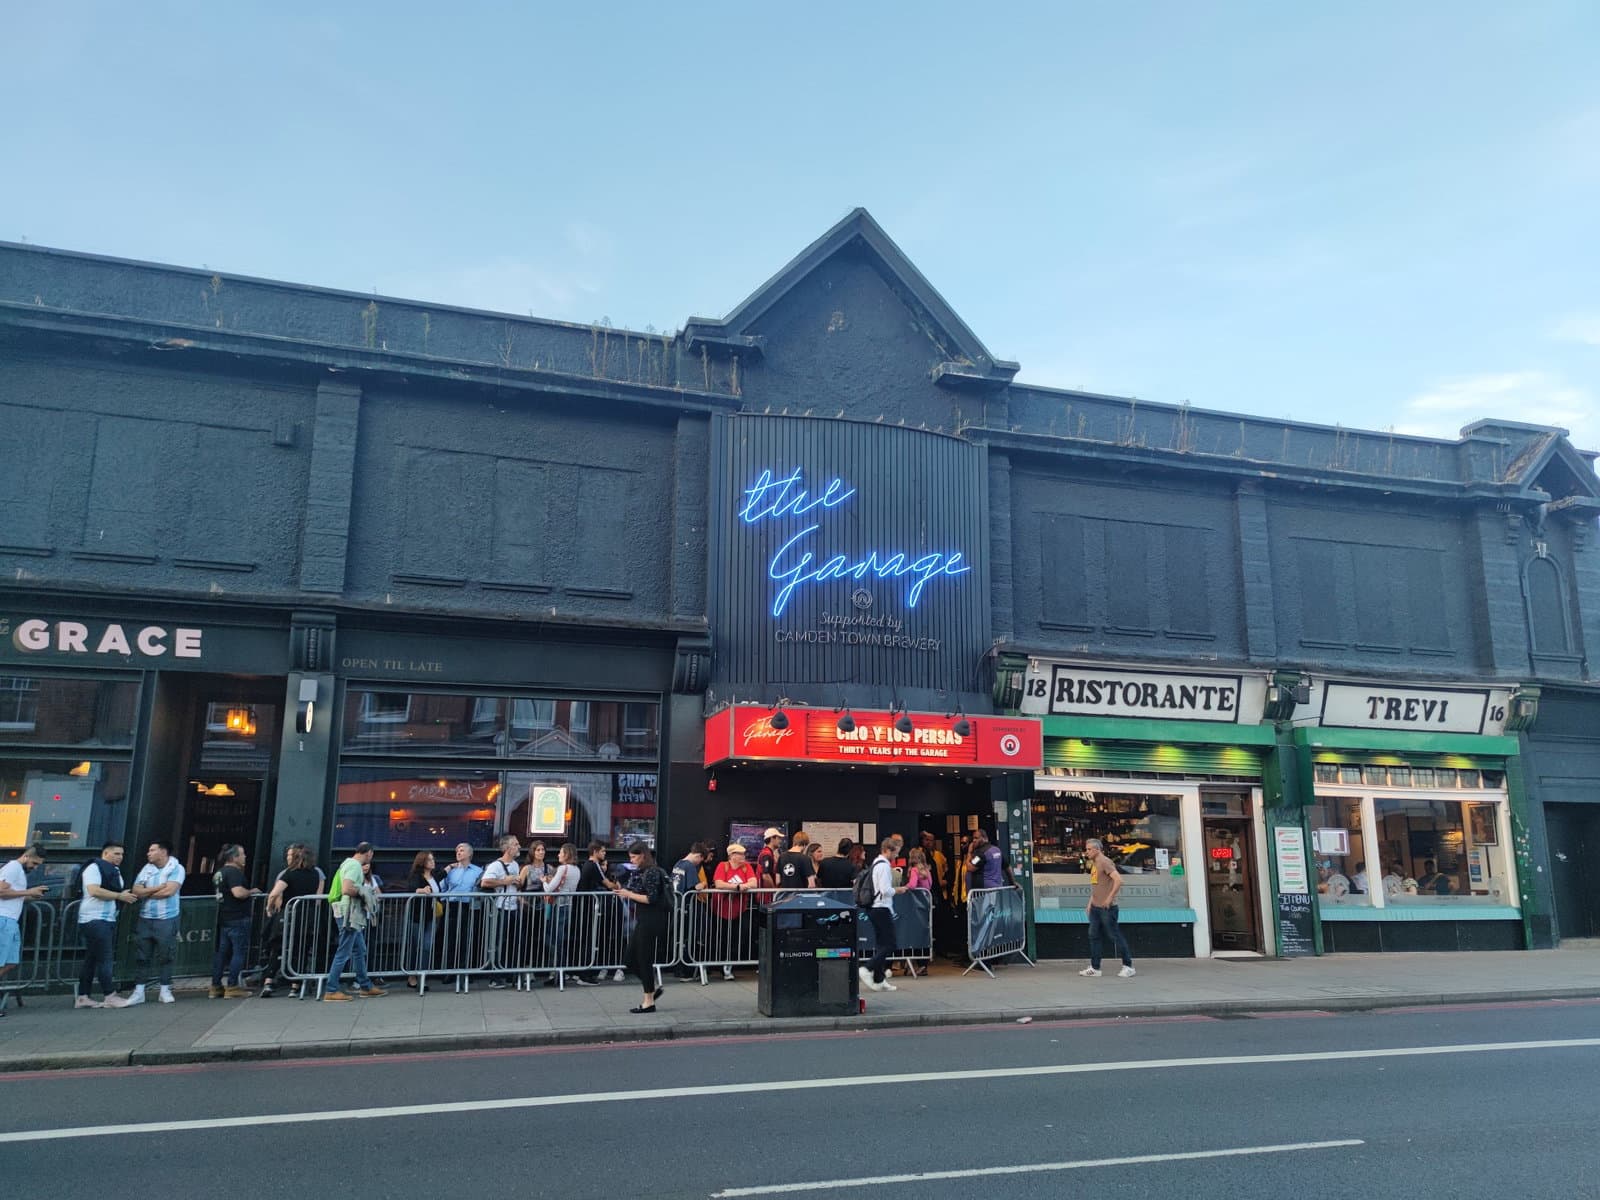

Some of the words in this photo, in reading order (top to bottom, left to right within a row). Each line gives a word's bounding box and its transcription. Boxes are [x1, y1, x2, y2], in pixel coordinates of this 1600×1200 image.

[739, 467, 856, 522] the
[770, 525, 971, 616] Garage
[820, 612, 885, 630] Supported
[887, 615, 904, 632] by
[15, 619, 202, 658] GRACE
[774, 629, 837, 644] CAMDEN
[840, 631, 881, 646] TOWN
[884, 634, 942, 651] BREWERY
[342, 658, 378, 669] OPEN
[383, 660, 405, 671] TIL
[409, 661, 443, 672] LATE
[1026, 679, 1047, 697] 18
[1055, 677, 1235, 712] RISTORANTE
[1366, 695, 1449, 723] TREVI
[1489, 705, 1504, 722] 16
[743, 722, 795, 747] Garage
[872, 726, 885, 742] Y
[914, 728, 963, 745] PERSAS
[839, 746, 865, 755] THIRTY
[868, 747, 892, 756] YEARS
[893, 748, 903, 756] OF
[905, 748, 919, 757] THE
[920, 749, 949, 758] GARAGE
